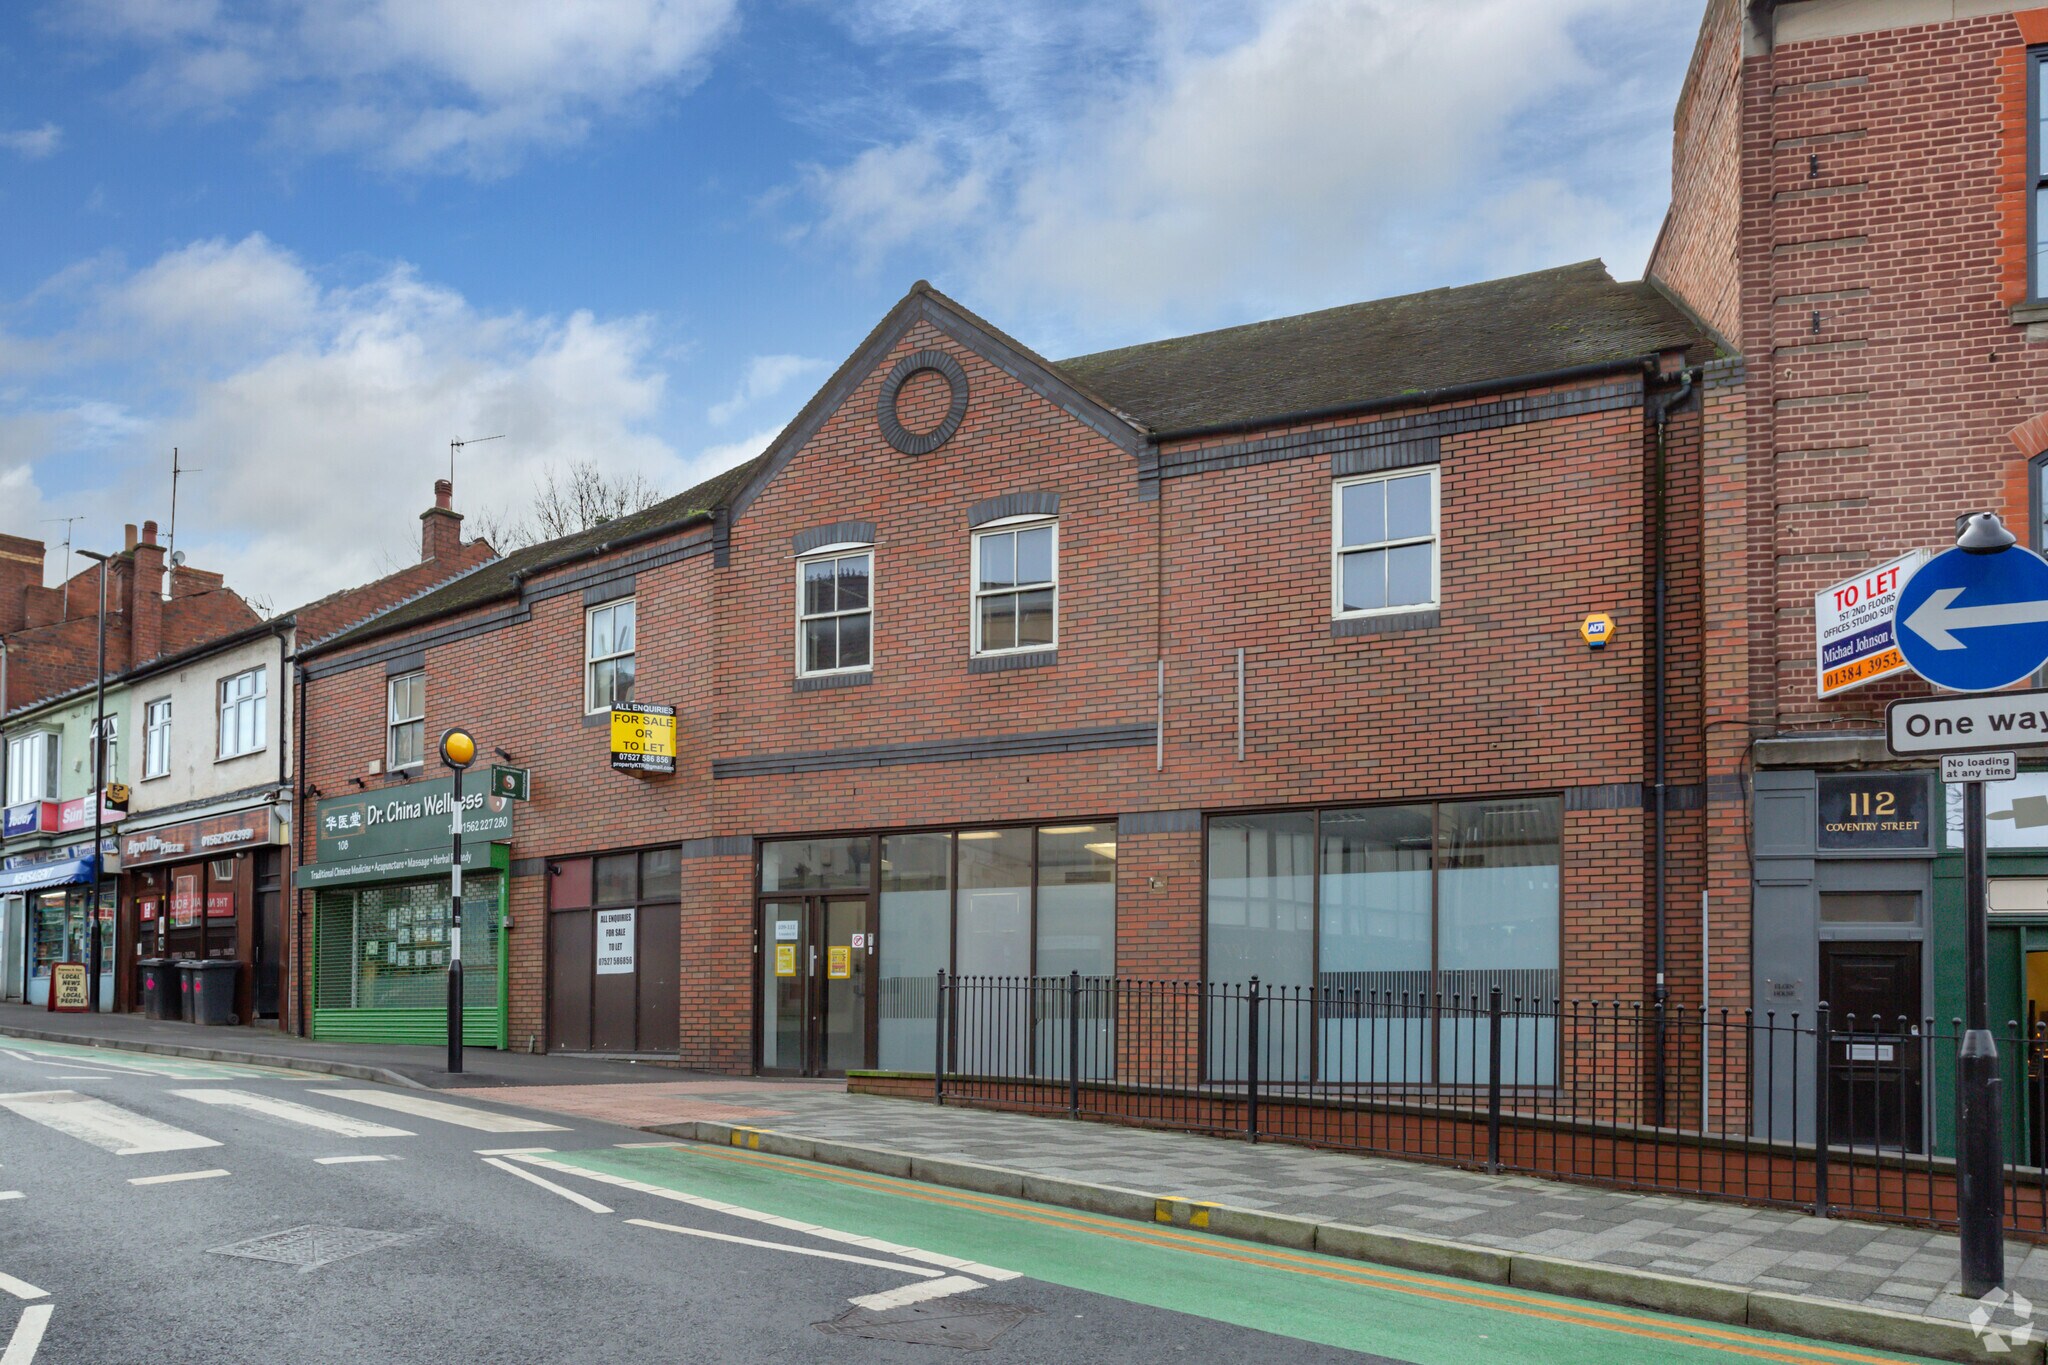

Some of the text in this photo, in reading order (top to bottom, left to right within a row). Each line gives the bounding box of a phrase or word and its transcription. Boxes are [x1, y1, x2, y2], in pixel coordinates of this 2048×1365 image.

[1834, 566, 1900, 612] TO LET
[1868, 592, 1896, 612] FLOORS
[1588, 622, 1606, 633] ADT
[1823, 631, 1889, 664] Michael Johnson
[1826, 663, 1862, 688] 01384
[615, 702, 674, 715] ALL ENQUIRIES
[614, 713, 674, 728] FOR SALE
[1905, 713, 1975, 738] One
[635, 728, 653, 739] OR
[622, 740, 665, 753] TO LET
[618, 752, 669, 764] 07527 586 856
[1947, 756, 2010, 768] No loading
[1946, 767, 2011, 779] at any time
[1849, 791, 1896, 816] 112
[62, 807, 83, 824] Sun
[367, 804, 385, 826] Dr.
[386, 800, 421, 823] China
[325, 811, 362, 832] 华医堂
[461, 819, 480, 834] 1562
[480, 817, 494, 831] 227
[494, 815, 508, 829] 280
[1825, 821, 1920, 832] COVENTRY STREET
[76, 844, 96, 857] Evenin
[127, 835, 163, 858] Apollo
[310, 867, 334, 880] Traditional
[334, 867, 351, 877] Chinese
[351, 865, 372, 876] Medicine
[374, 860, 405, 874] Acupuncture
[407, 857, 431, 869] Massage
[433, 853, 450, 865] Herbal
[600, 913, 632, 923] ALL ENQUIRIES
[605, 928, 626, 937] FOR SALE
[608, 942, 623, 951] TO LET
